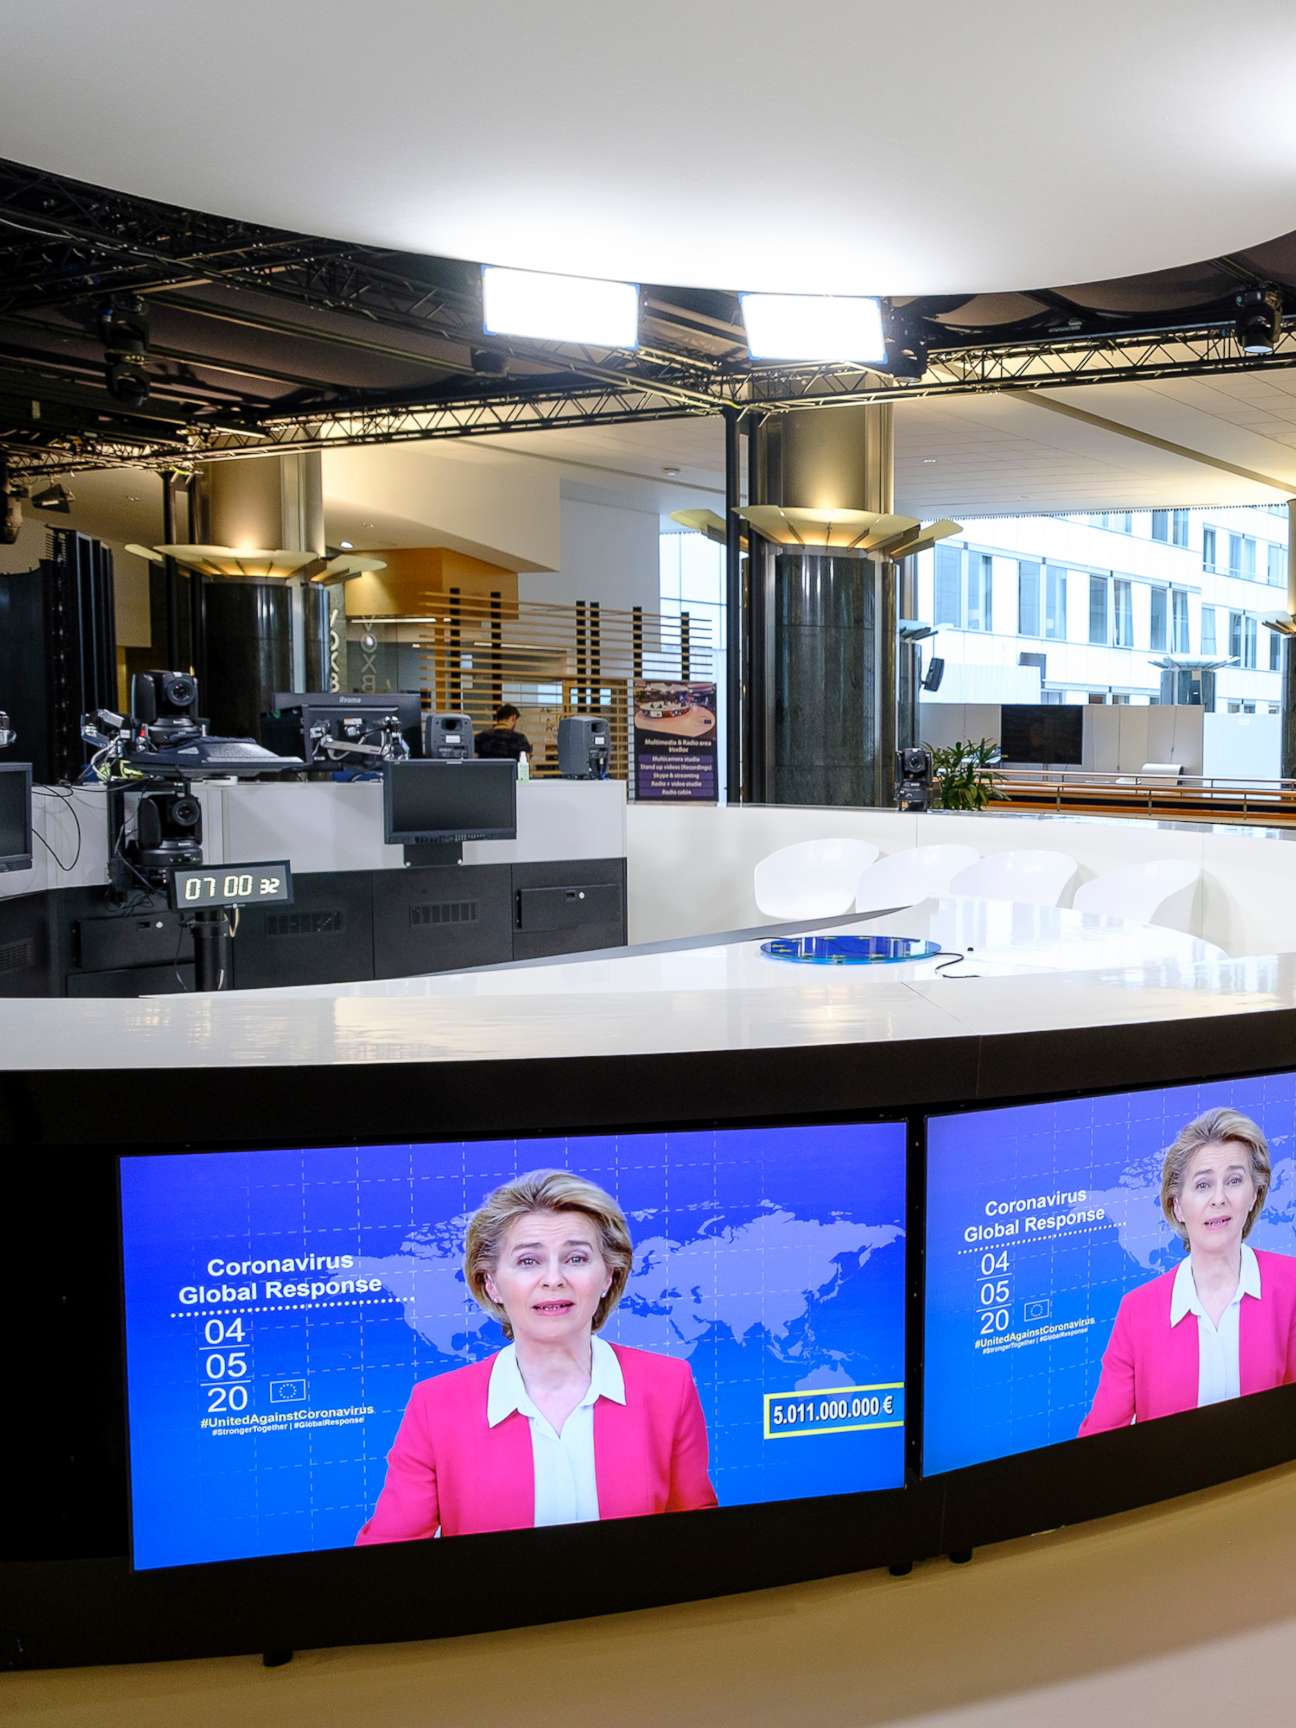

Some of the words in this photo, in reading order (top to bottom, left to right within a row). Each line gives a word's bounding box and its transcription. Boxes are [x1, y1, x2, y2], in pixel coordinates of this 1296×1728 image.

[185, 877, 216, 900] 07
[224, 874, 253, 897] 00
[260, 878, 280, 894] 32
[985, 1190, 1088, 1216] Coronavirus
[964, 1220, 1019, 1242] Global
[1025, 1208, 1105, 1232] Response
[207, 1254, 354, 1276] Coronavirus
[981, 1250, 1010, 1275] 04
[178, 1282, 257, 1304] Global
[266, 1278, 382, 1300] Response
[980, 1280, 1010, 1305] 05
[204, 1318, 246, 1344] 04
[975, 1317, 1096, 1348] #UnitedAgainstCoronavirus
[980, 1309, 1009, 1335] 20
[205, 1352, 248, 1380] 05
[207, 1386, 248, 1413] 20
[774, 1396, 879, 1424] 5.011.000.000
[883, 1396, 893, 1414] €
[200, 1404, 374, 1428] #UnitedAgainstCoronavirus
[212, 1422, 288, 1436] #StrongerTogether
[294, 1416, 364, 1430] #GlobalResponse
